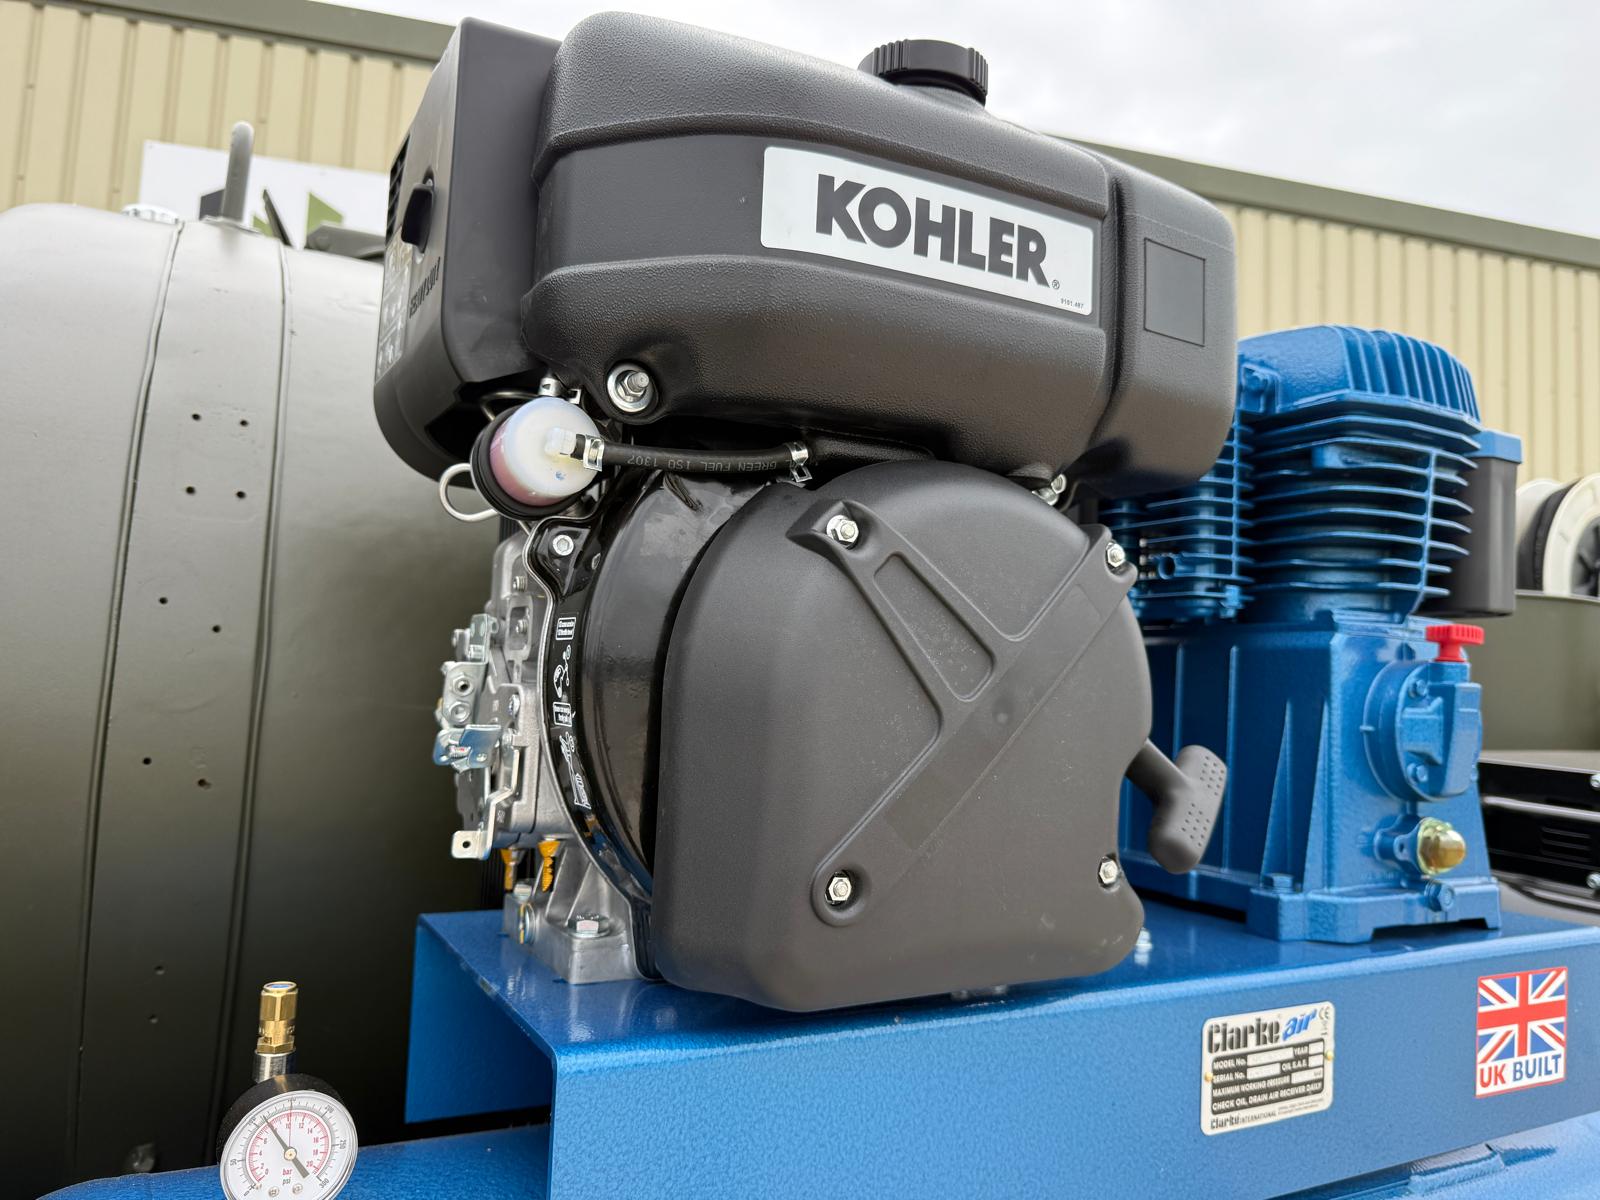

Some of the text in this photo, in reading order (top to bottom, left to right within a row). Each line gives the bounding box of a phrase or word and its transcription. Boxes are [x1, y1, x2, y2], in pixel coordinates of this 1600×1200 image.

[816, 174, 1050, 288] KOHLER
[627, 454, 658, 466] 1307
[668, 458, 691, 470] ISO
[700, 460, 730, 472] FUEL
[738, 460, 777, 472] GREEN
[1208, 1018, 1280, 1053] Clarke
[1282, 1009, 1318, 1041] air
[1213, 1058, 1235, 1070] MODEL
[1212, 1072, 1234, 1083] SERIAL
[1281, 1061, 1292, 1071] OIL
[1480, 1053, 1561, 1088] UK BUILT
[1212, 1085, 1240, 1097] MAXIMUM
[1240, 1080, 1267, 1092] WORKING
[1212, 1099, 1234, 1111] CHECK
[1248, 1093, 1268, 1104] DRAIN
[1268, 1091, 1279, 1100] AIR
[1280, 1085, 1306, 1097] RECEIVER
[282, 1168, 293, 1176] bar
[282, 1176, 292, 1186] psi
